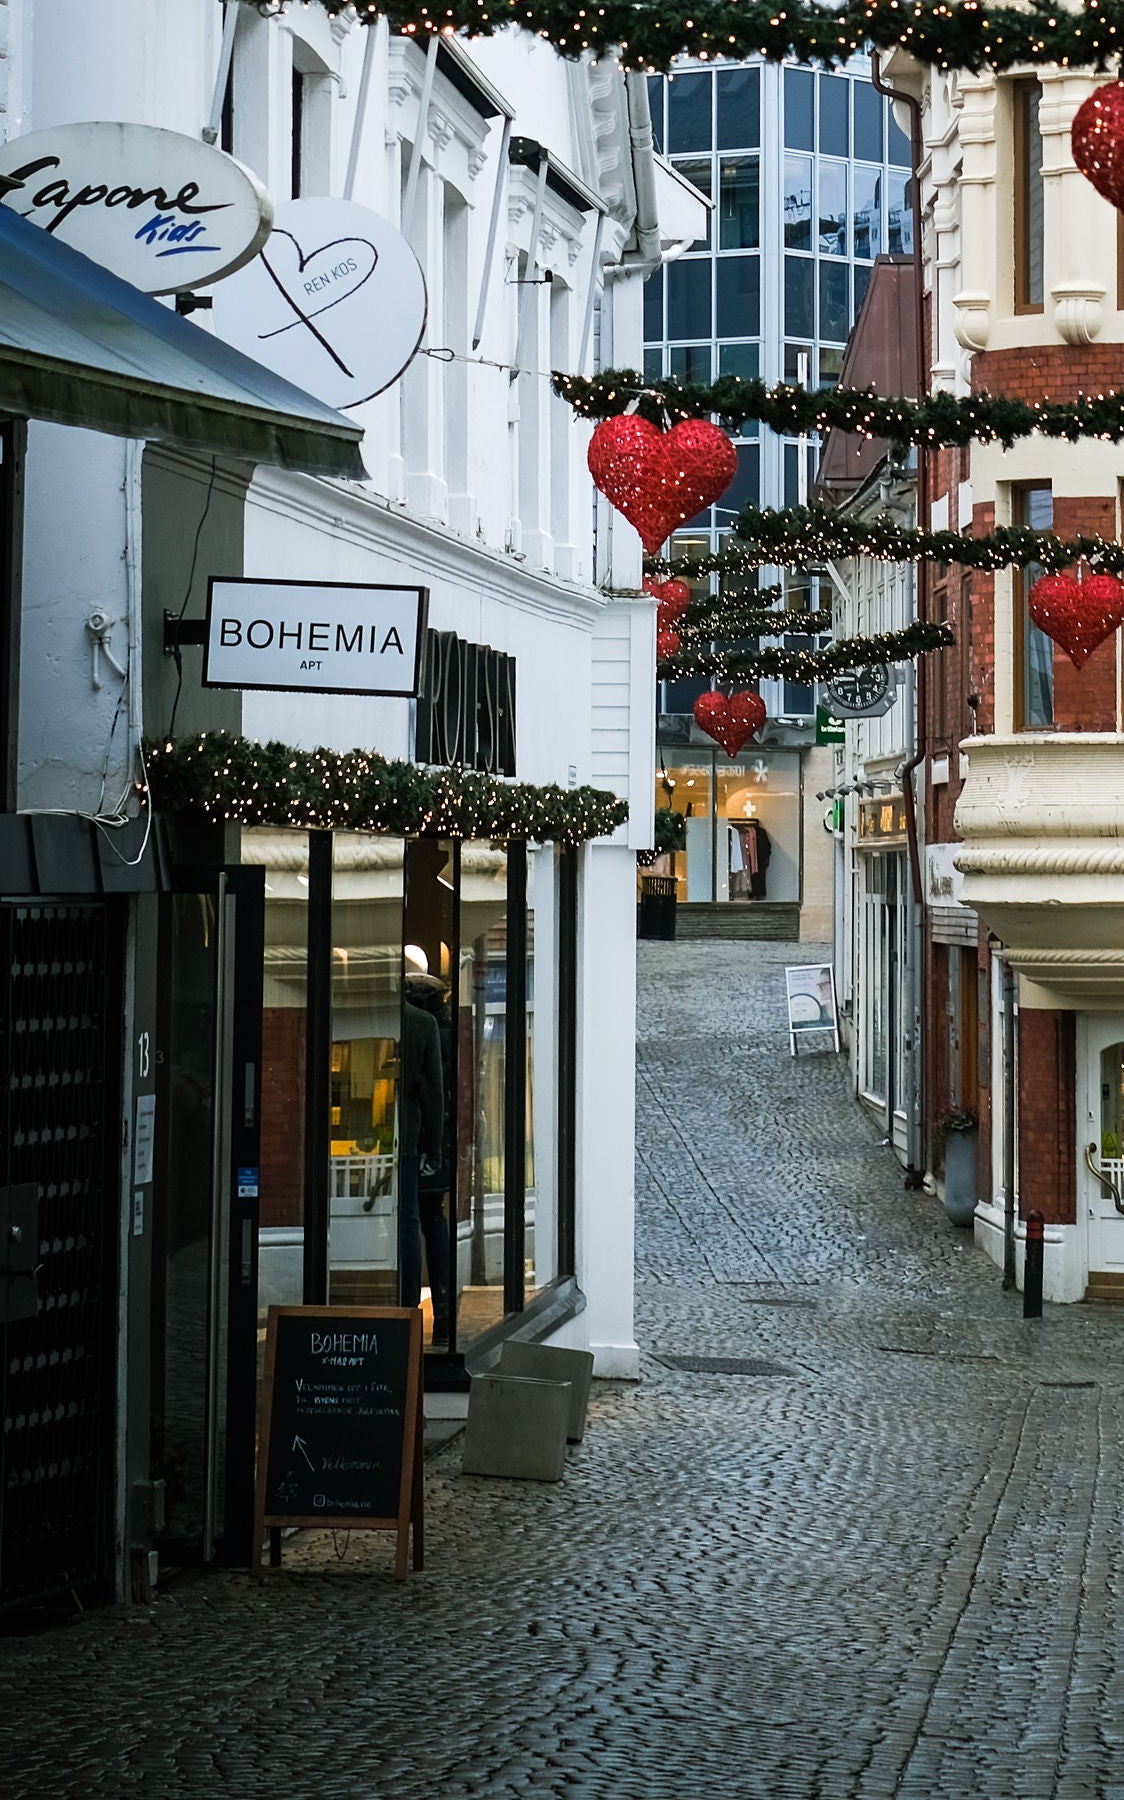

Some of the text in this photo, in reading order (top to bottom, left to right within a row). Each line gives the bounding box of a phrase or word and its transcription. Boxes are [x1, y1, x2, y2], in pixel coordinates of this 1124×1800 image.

[134, 214, 207, 245] Kids
[303, 258, 358, 296] REN KOS
[220, 618, 404, 654] BOHEMIA
[299, 660, 323, 671] APT
[138, 1032, 150, 1077] 13
[311, 1332, 378, 1355] BOHEMIA
